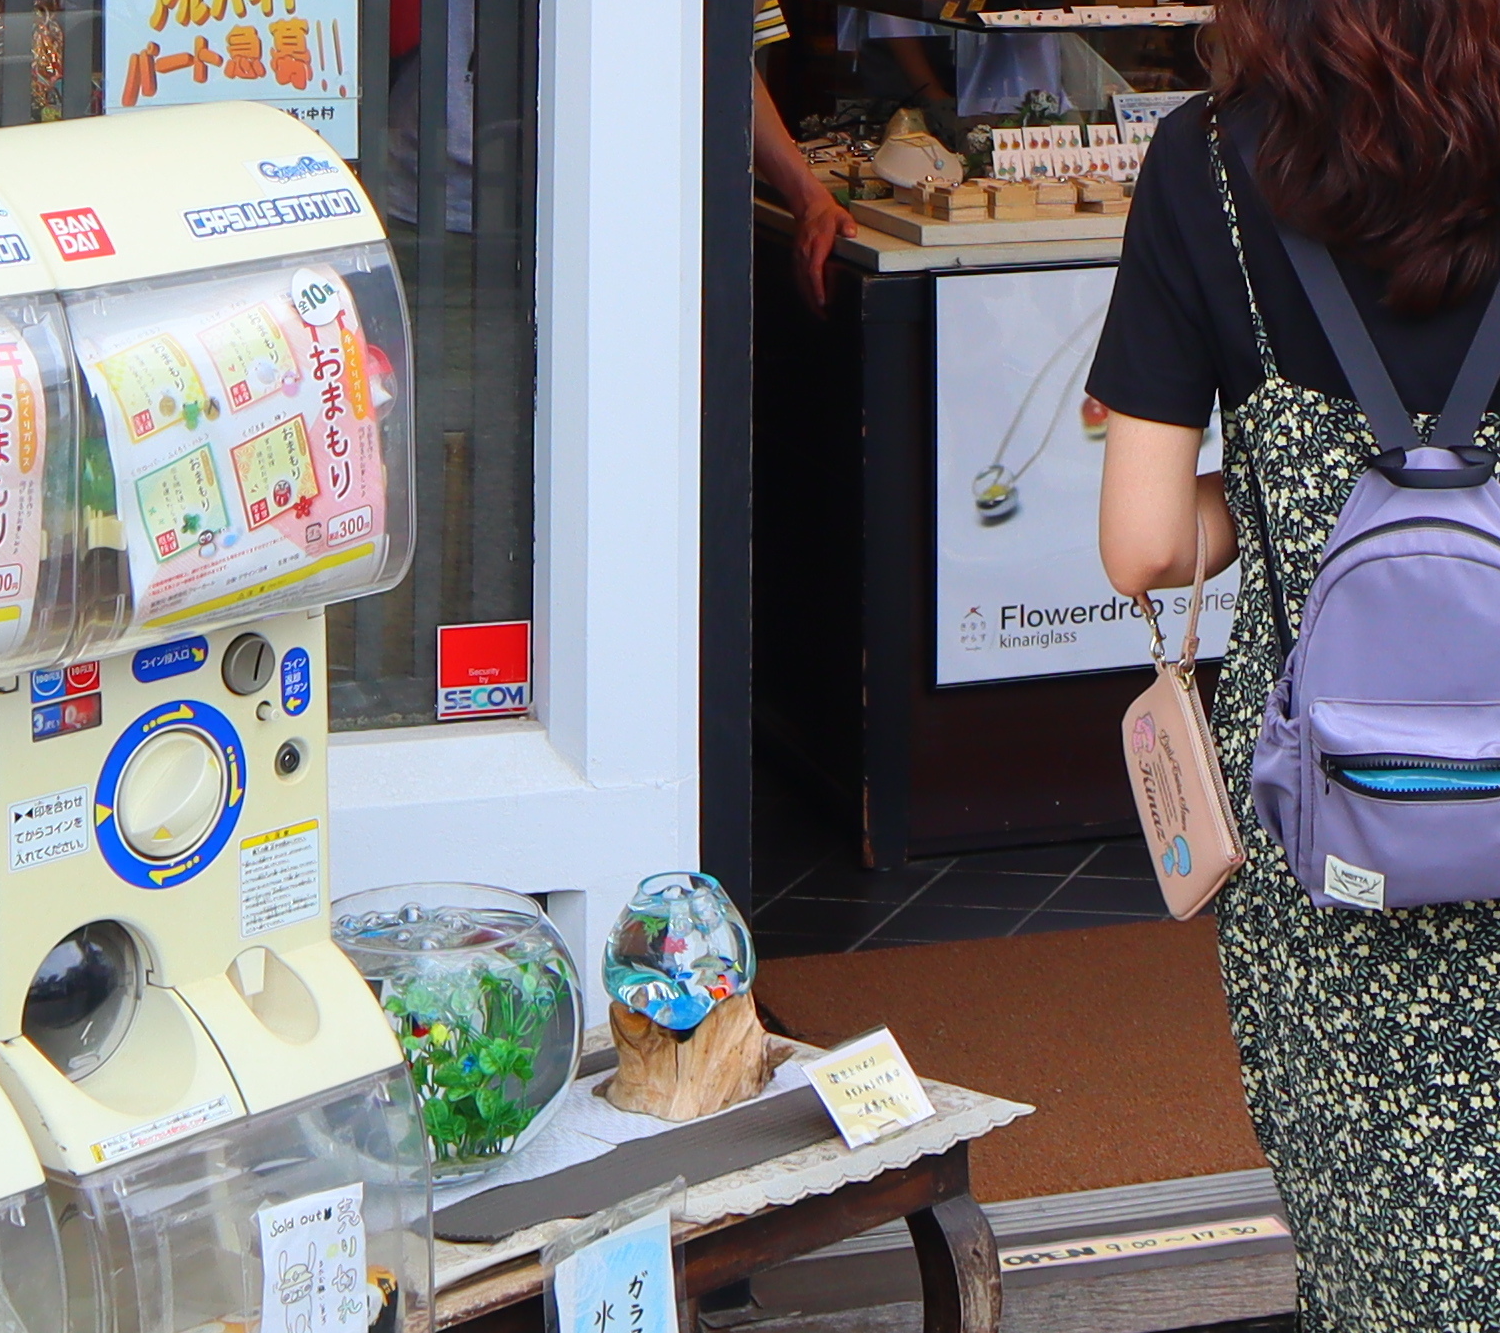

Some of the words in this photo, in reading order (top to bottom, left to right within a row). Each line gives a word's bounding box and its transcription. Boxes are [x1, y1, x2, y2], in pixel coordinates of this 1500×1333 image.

[48, 212, 97, 239] BAN
[56, 233, 101, 258] DAI
[344, 334, 365, 414] 手づくりガラス
[19, 383, 33, 467] 手づくりガラス
[309, 345, 351, 500] おまもり
[282, 428, 300, 480] おまもり
[189, 456, 210, 512] おまもり
[1000, 629, 1078, 650] kinariglass
[140, 650, 190, 670] コイン投入口
[284, 657, 307, 671] コイン
[468, 667, 500, 676] Security
[284, 682, 308, 696] ボタン
[479, 676, 489, 684] by
[444, 686, 524, 710] SECOM
[15, 818, 83, 844] てからコインを
[14, 840, 83, 866] 入れてください。
[270, 1217, 295, 1238] Sold
[300, 1210, 322, 1225] out
[332, 1197, 363, 1324] 売り切れ
[1002, 1246, 1098, 1266] OPEN
